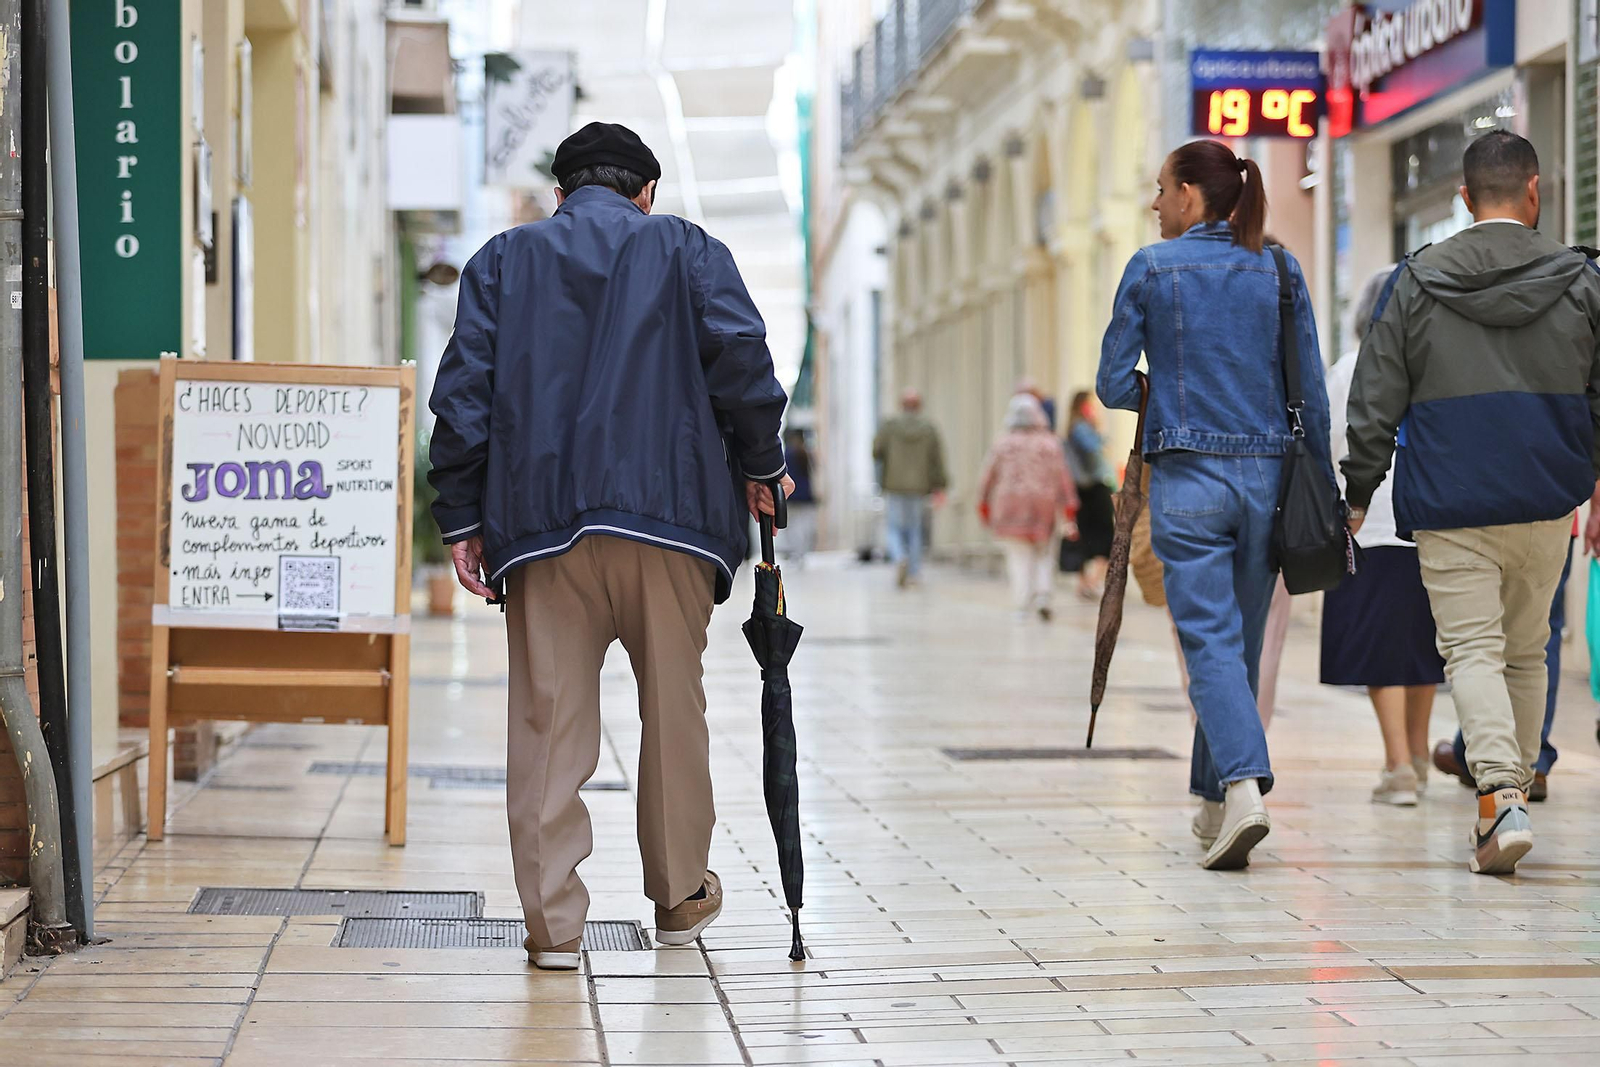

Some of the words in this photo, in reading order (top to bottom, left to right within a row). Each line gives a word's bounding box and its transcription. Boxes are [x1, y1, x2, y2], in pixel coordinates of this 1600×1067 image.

[1208, 88, 1251, 137] 19
[114, 0, 140, 258] bolario
[179, 383, 252, 413] ¿HACES
[275, 387, 369, 417] DEPORTE?
[237, 421, 330, 451] NOVEDAD
[336, 458, 374, 471] SPORT
[181, 510, 241, 529] nueva
[250, 515, 301, 541] gama
[308, 508, 328, 527] de
[182, 534, 301, 559] complementos
[310, 525, 388, 557] deportivos
[182, 563, 222, 580] más
[182, 584, 231, 607] ENTRA
[1502, 792, 1519, 801] NIKE
